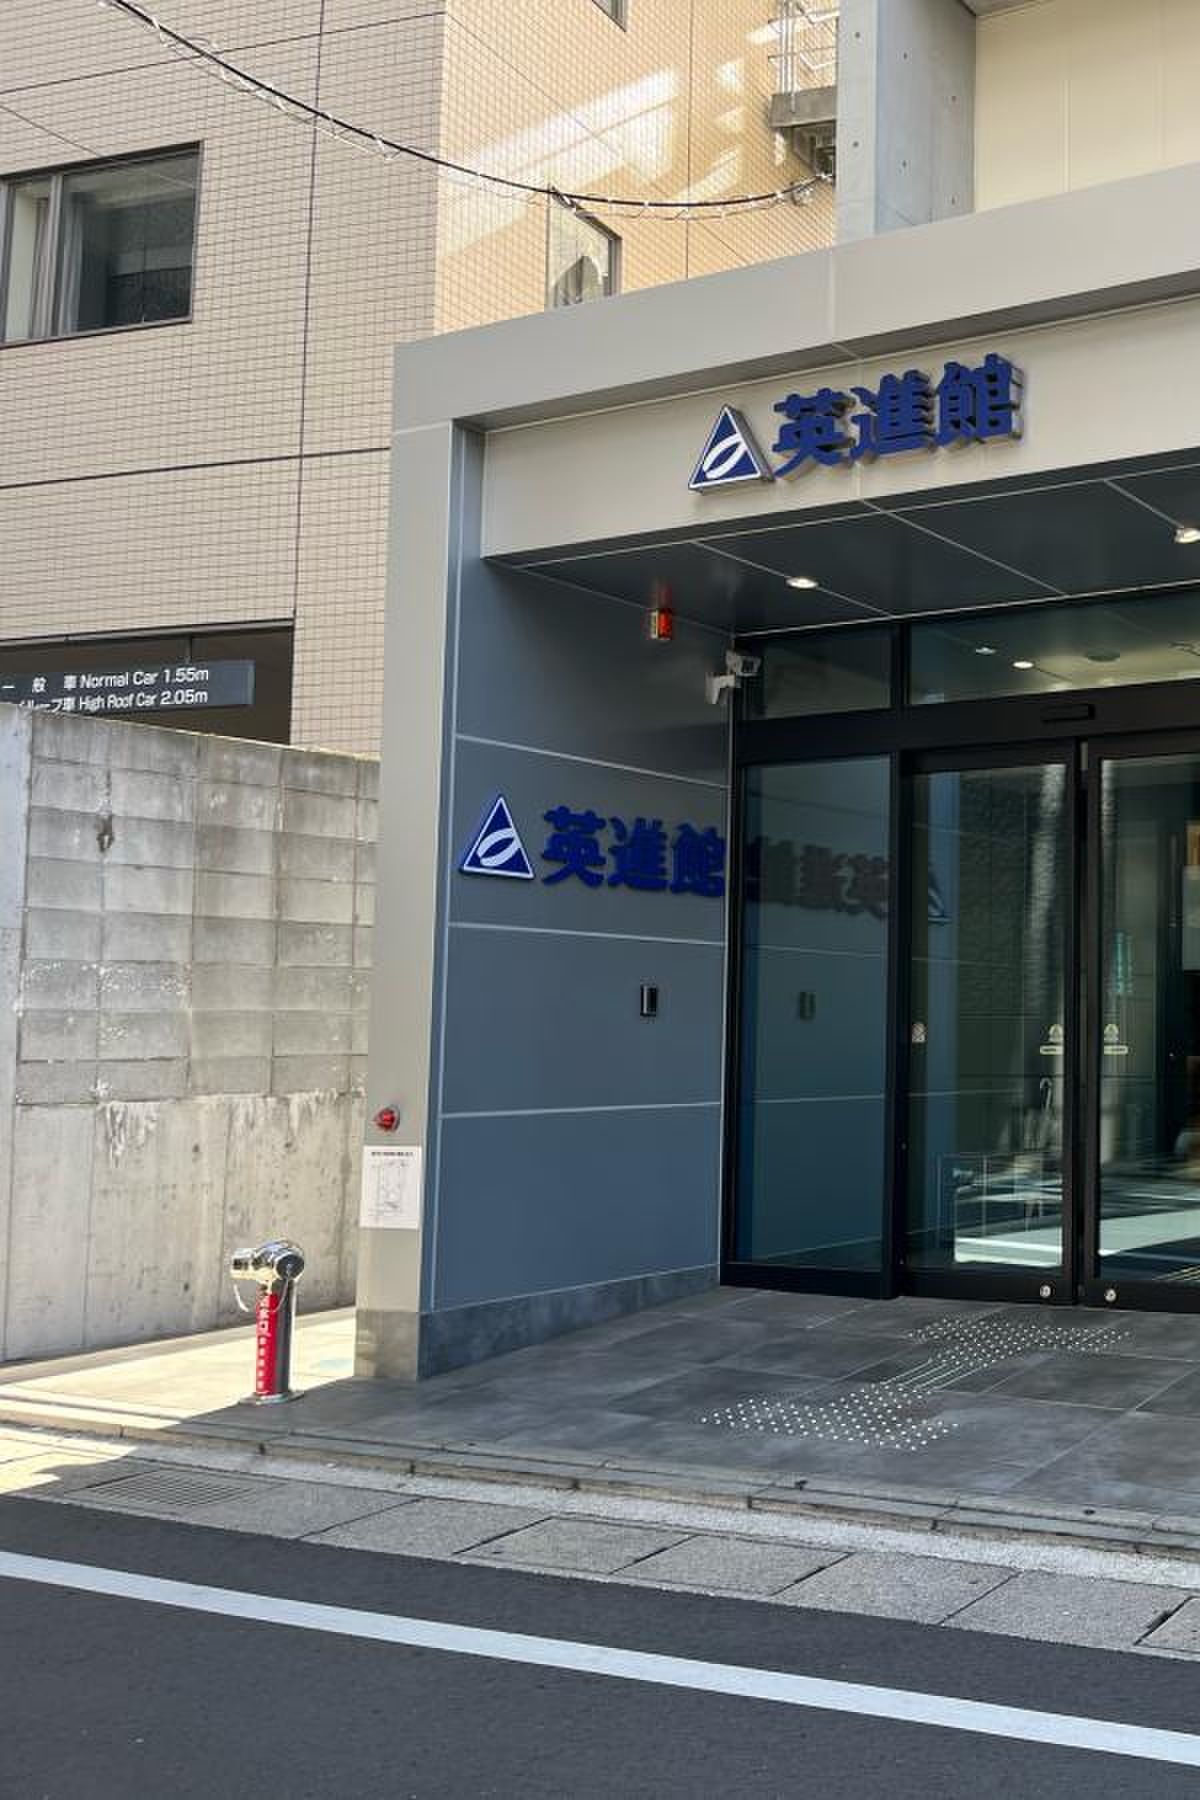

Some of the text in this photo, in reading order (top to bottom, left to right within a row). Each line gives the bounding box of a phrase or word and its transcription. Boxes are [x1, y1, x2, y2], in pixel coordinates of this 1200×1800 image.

[772, 353, 1023, 478] 英進館
[79, 695, 105, 712] High
[107, 694, 134, 709] Roof
[136, 692, 157, 708] Car
[160, 689, 208, 706] 2.05m
[80, 671, 129, 689] Normal
[132, 670, 157, 686] Car
[163, 667, 209, 684] 1.55m
[542, 805, 727, 897] 英進館
